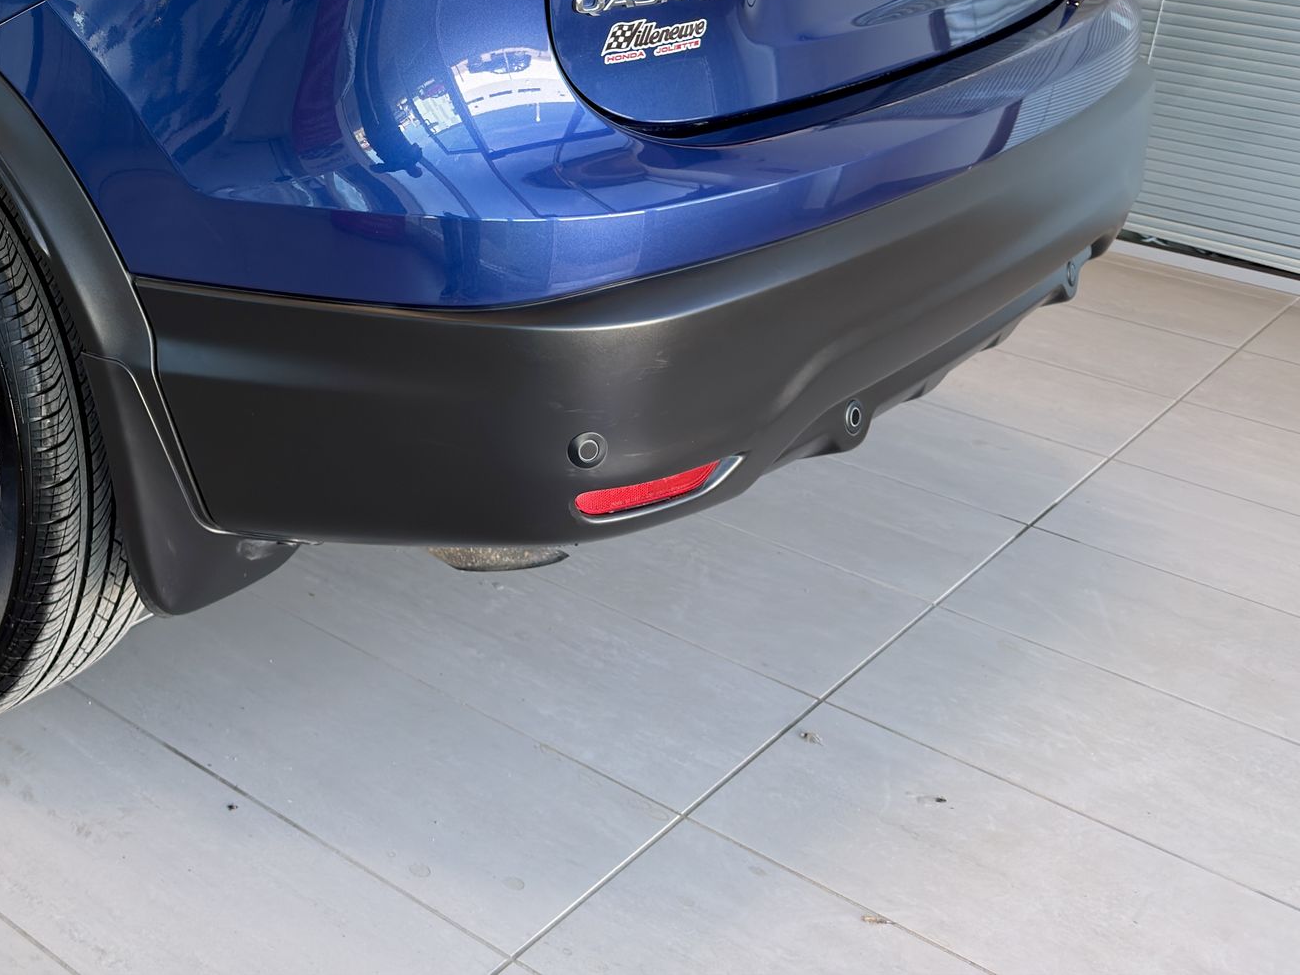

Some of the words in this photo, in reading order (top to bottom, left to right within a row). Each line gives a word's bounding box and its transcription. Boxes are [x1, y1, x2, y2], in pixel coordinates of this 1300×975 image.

[606, 20, 705, 50] Villeneuve
[606, 51, 645, 63] HONDA
[655, 40, 700, 54] JOLIETTE
